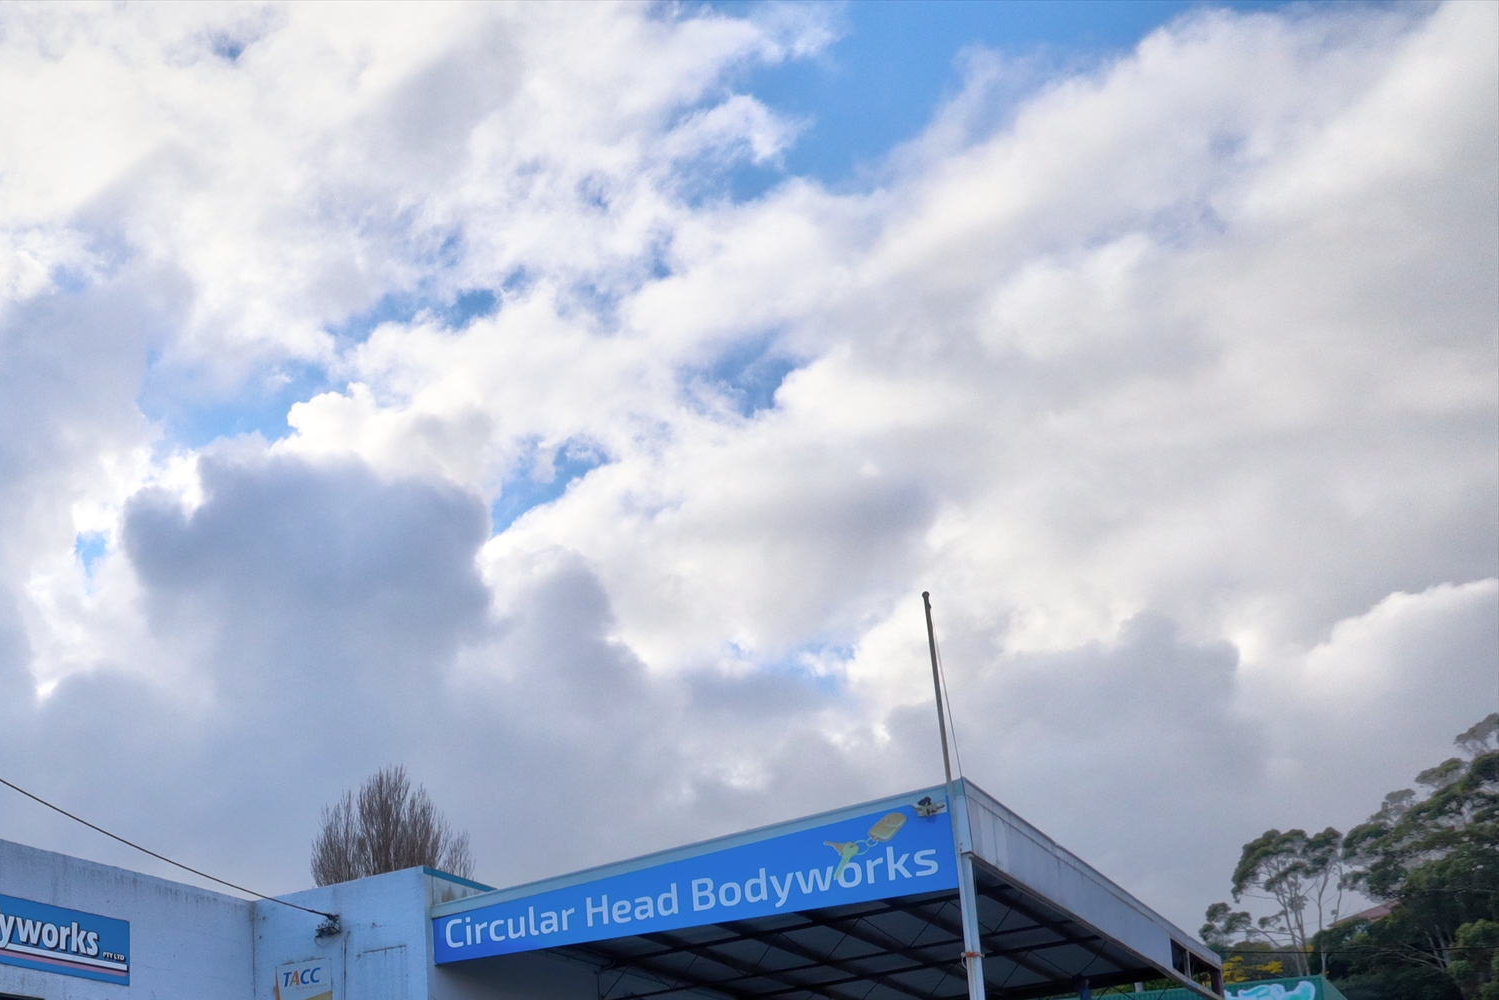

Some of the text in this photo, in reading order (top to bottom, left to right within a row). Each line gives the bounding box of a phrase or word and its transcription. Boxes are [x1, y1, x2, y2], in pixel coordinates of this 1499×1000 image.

[445, 845, 939, 949] Circular Head Bodyworks
[103, 951, 114, 959] PTY
[283, 967, 321, 988] TACC
